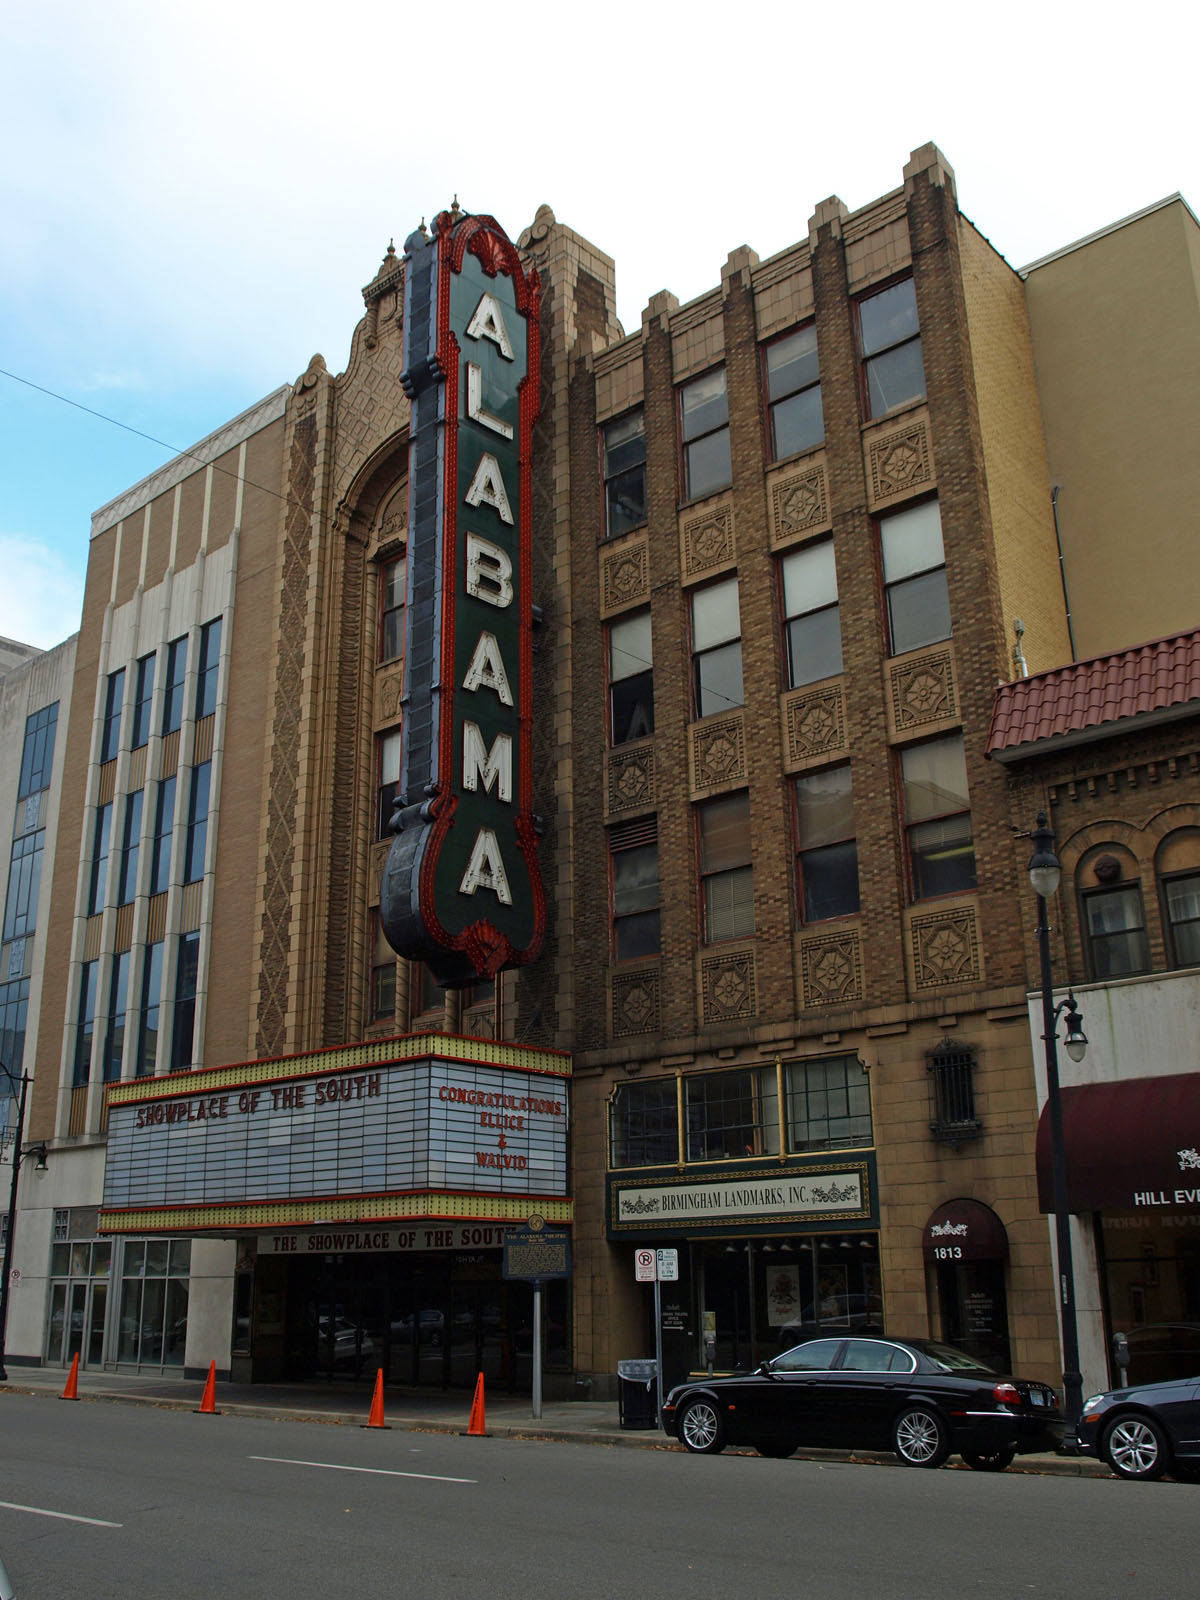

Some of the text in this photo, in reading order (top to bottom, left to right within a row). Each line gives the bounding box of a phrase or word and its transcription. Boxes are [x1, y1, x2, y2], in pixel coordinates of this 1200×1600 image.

[459, 293, 515, 906] ALABAMA
[136, 1073, 381, 1128] SHOWPLACE OF THE SOUTH
[439, 1086, 562, 1116] CONGRATULATIONS
[480, 1112, 525, 1131] ELLICE
[498, 1133, 507, 1149] &
[476, 1152, 527, 1170] WALVID
[662, 1185, 810, 1211] BIRMINGHAM LANDMARKS, INC.
[1134, 1191, 1171, 1206] HILL
[273, 1227, 516, 1252] THE SHOWPLACE OF THE SOUT
[933, 1247, 962, 1259] 1813
